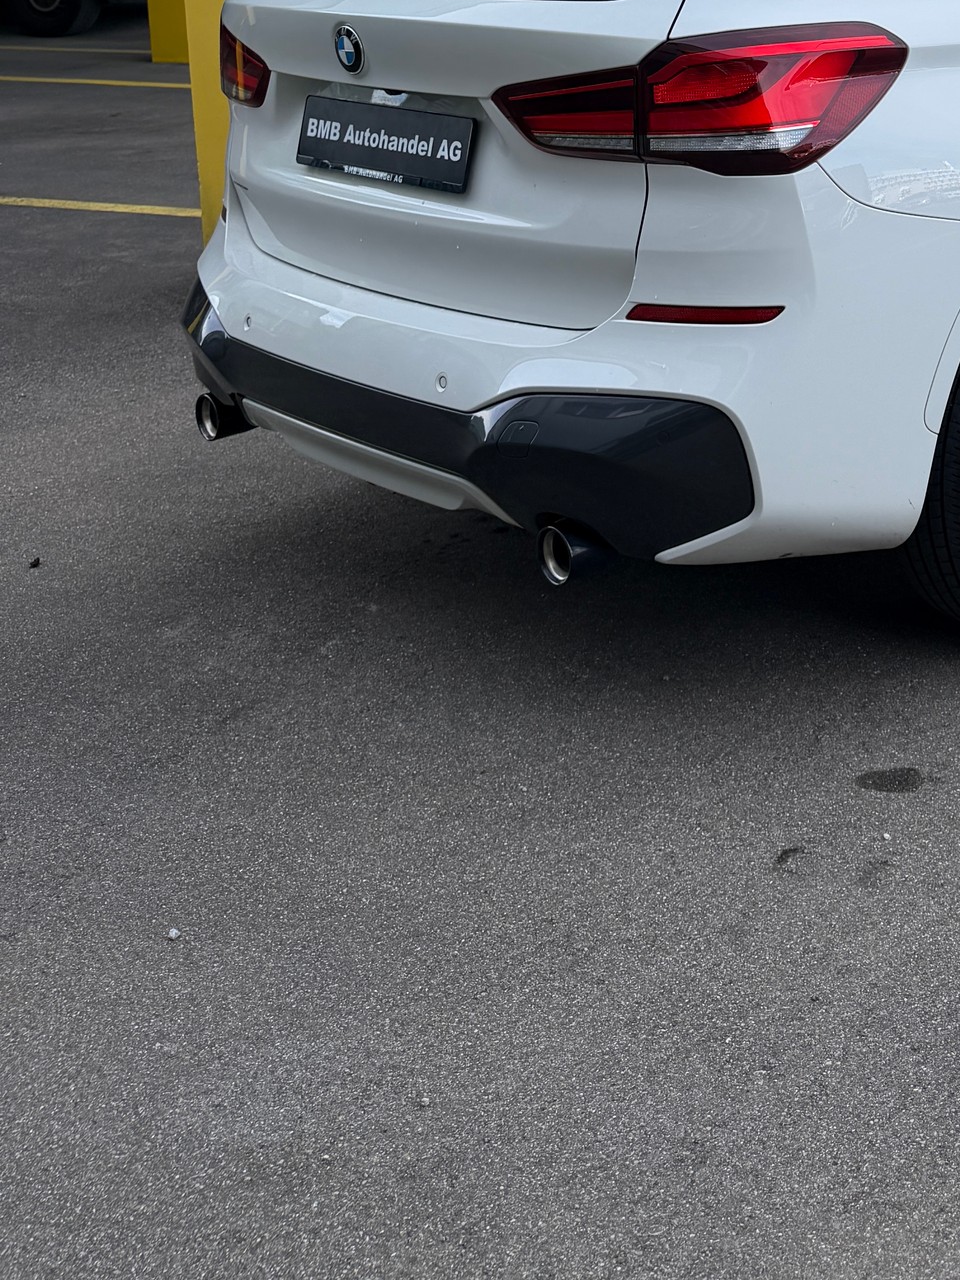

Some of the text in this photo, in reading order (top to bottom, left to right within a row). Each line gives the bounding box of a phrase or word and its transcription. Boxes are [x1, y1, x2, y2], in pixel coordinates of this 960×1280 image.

[306, 117, 463, 162] BMB Autohandel AG
[393, 175, 404, 184] AG
